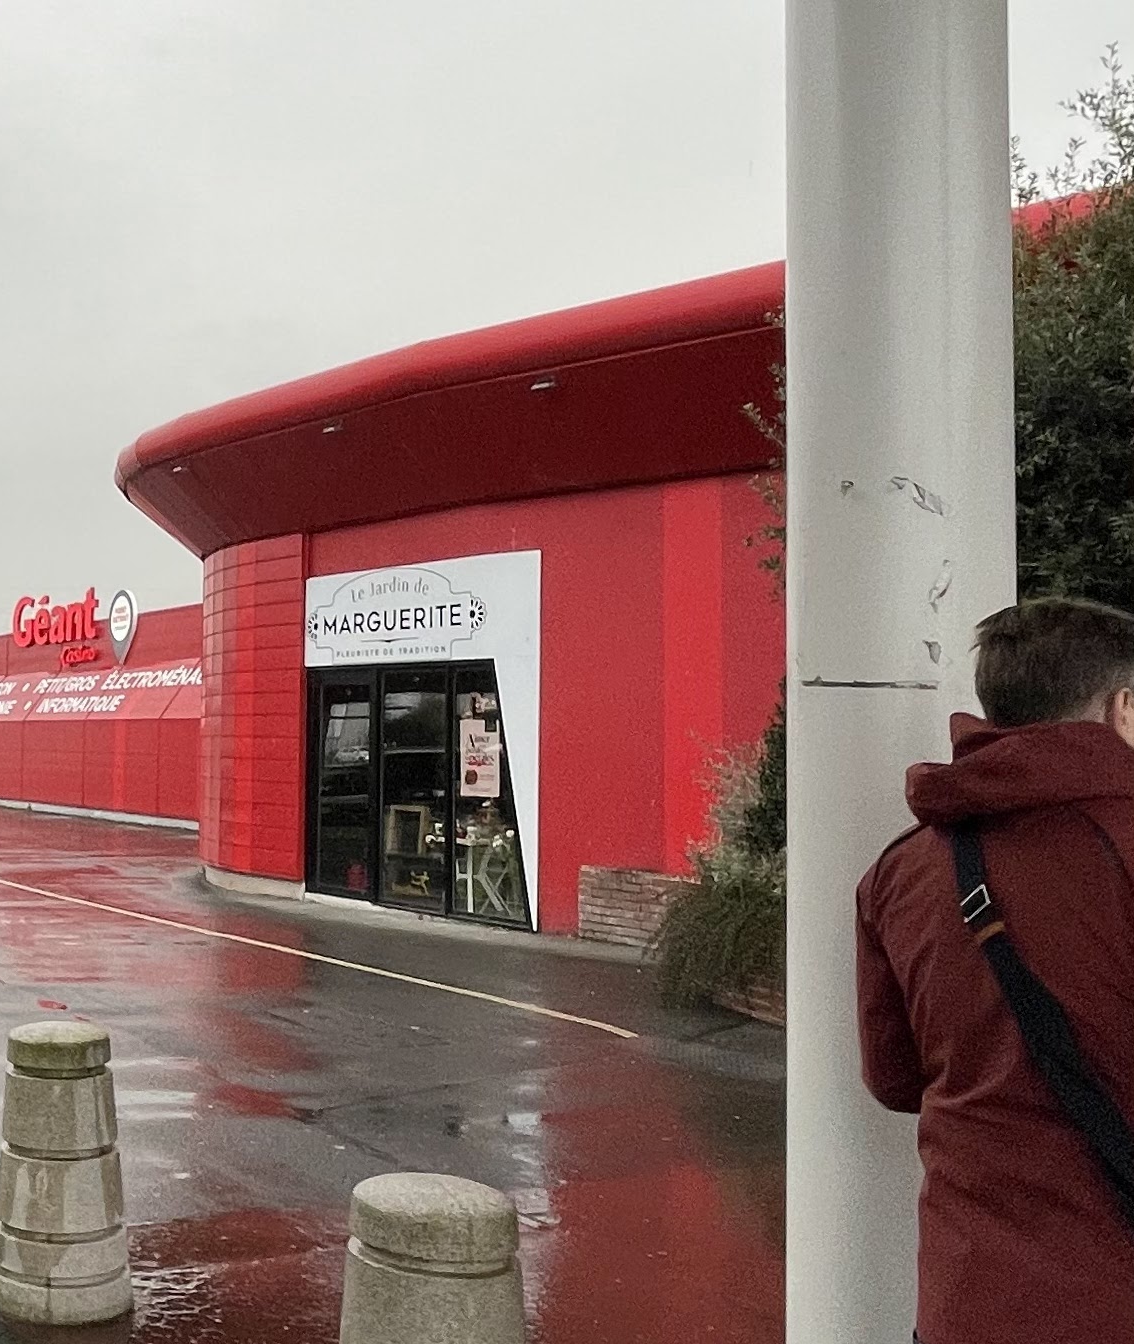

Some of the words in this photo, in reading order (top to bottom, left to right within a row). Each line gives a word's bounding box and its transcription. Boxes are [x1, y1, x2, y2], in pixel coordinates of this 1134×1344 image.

[351, 588, 365, 603] Le
[369, 576, 410, 597] Jardin
[414, 576, 429, 596] de
[13, 587, 99, 647] Géant
[323, 603, 463, 636] MARGUERITE
[336, 649, 379, 658] FLEURISTE
[383, 648, 394, 656] DE
[399, 645, 447, 655] TRADITION
[36, 695, 125, 713] INFORMATIQUE
